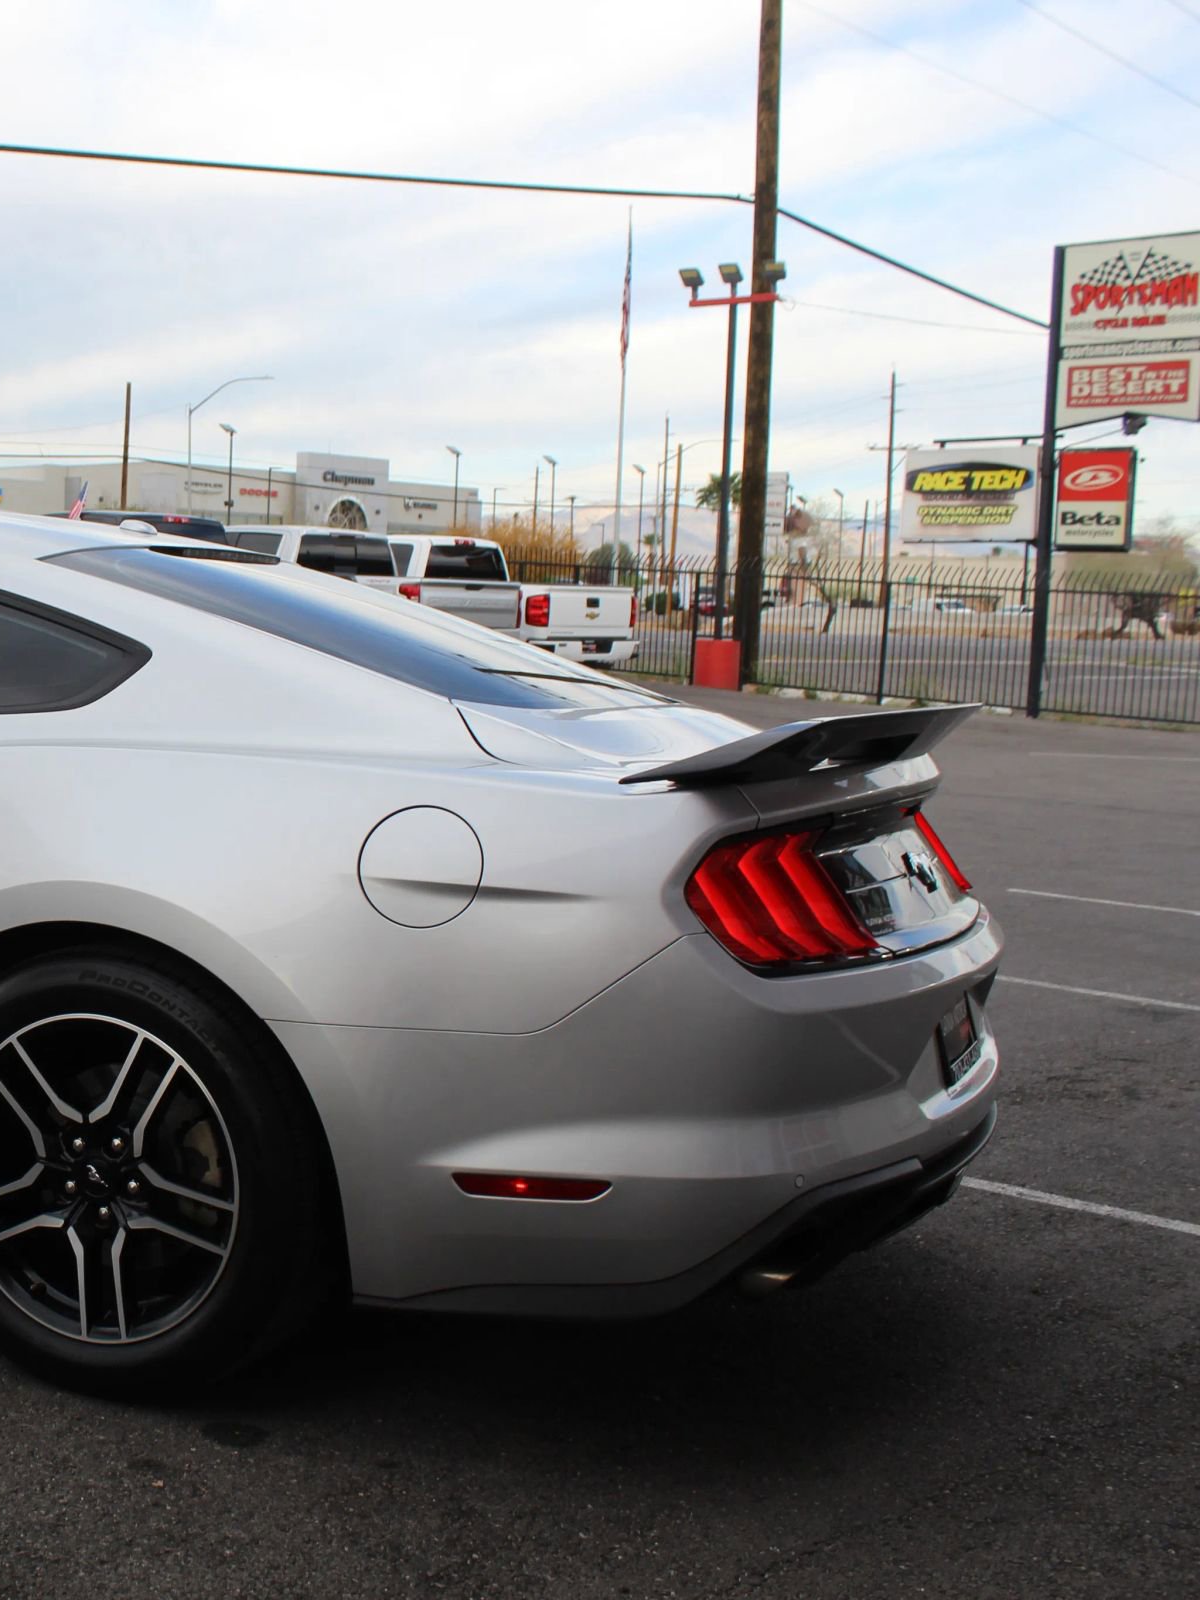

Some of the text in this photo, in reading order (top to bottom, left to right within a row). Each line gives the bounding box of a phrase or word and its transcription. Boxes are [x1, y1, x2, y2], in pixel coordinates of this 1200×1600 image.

[1070, 272, 1199, 316] SPORTSMAN
[1071, 365, 1148, 382] BEST
[1071, 379, 1186, 397] DESERT
[912, 469, 1027, 492] RACE TECH
[239, 487, 279, 498] DODGE
[918, 503, 1018, 516] DYNAMIC DIRT
[921, 515, 1013, 526] SUSPENSION
[1061, 511, 1122, 526] Beta
[1065, 529, 1115, 538] motorcycles
